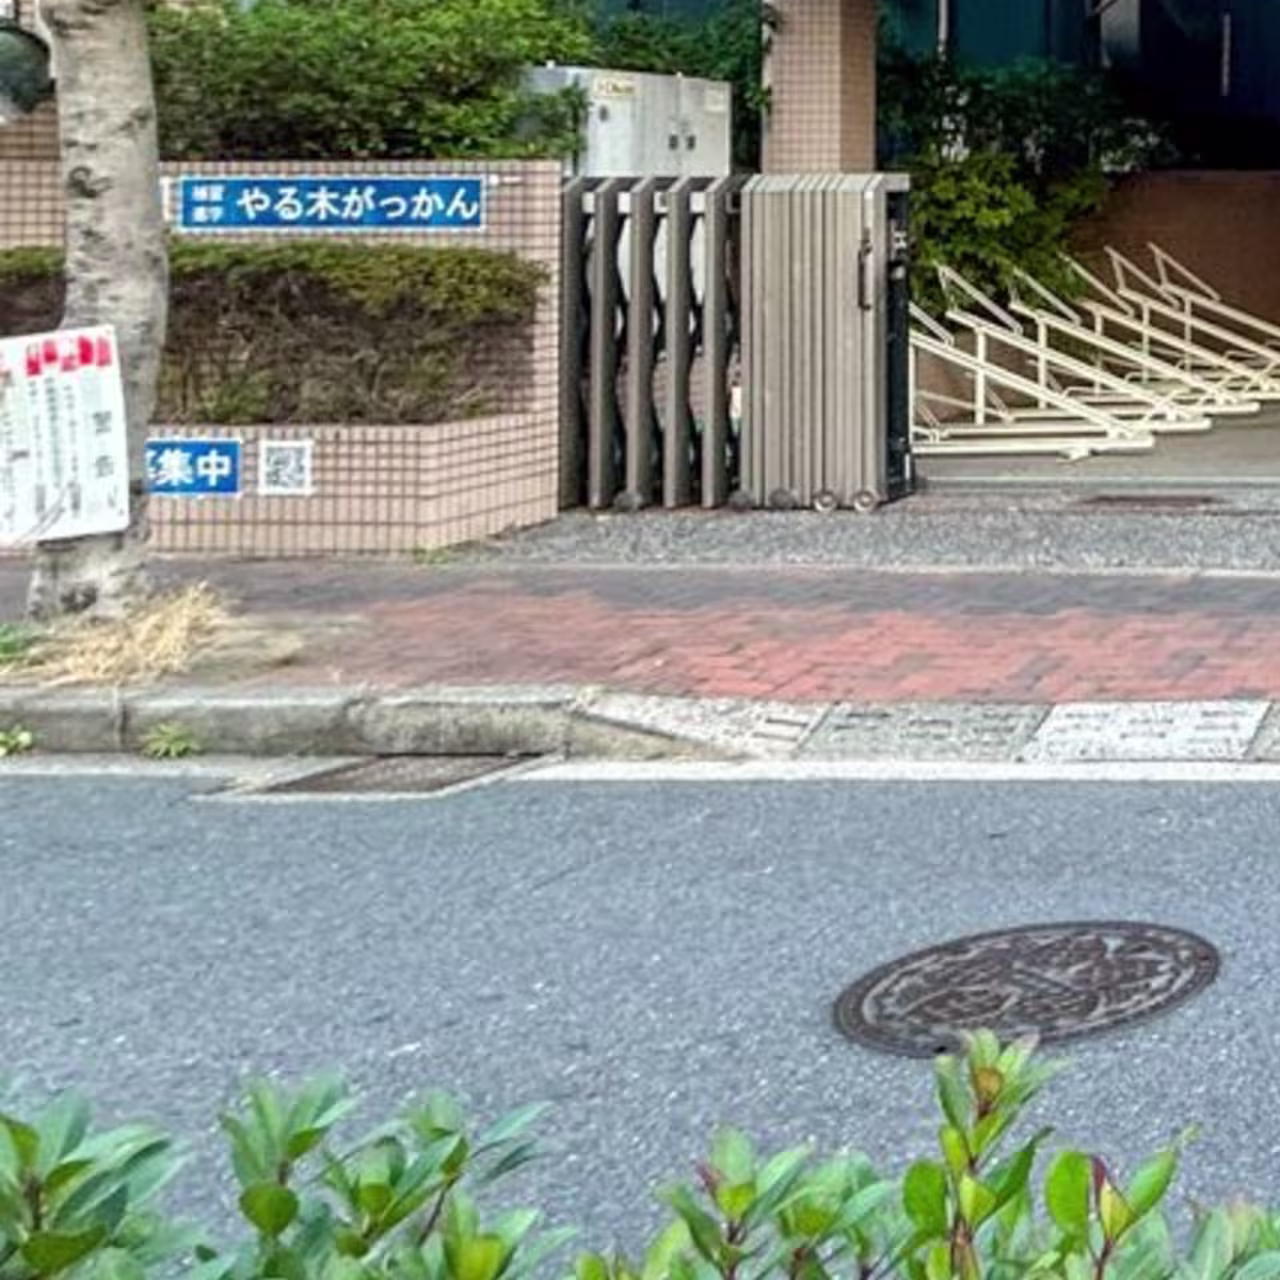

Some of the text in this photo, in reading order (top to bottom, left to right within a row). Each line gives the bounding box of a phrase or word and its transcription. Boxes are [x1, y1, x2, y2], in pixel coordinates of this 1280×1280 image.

[236, 185, 479, 221] やる木がっかん
